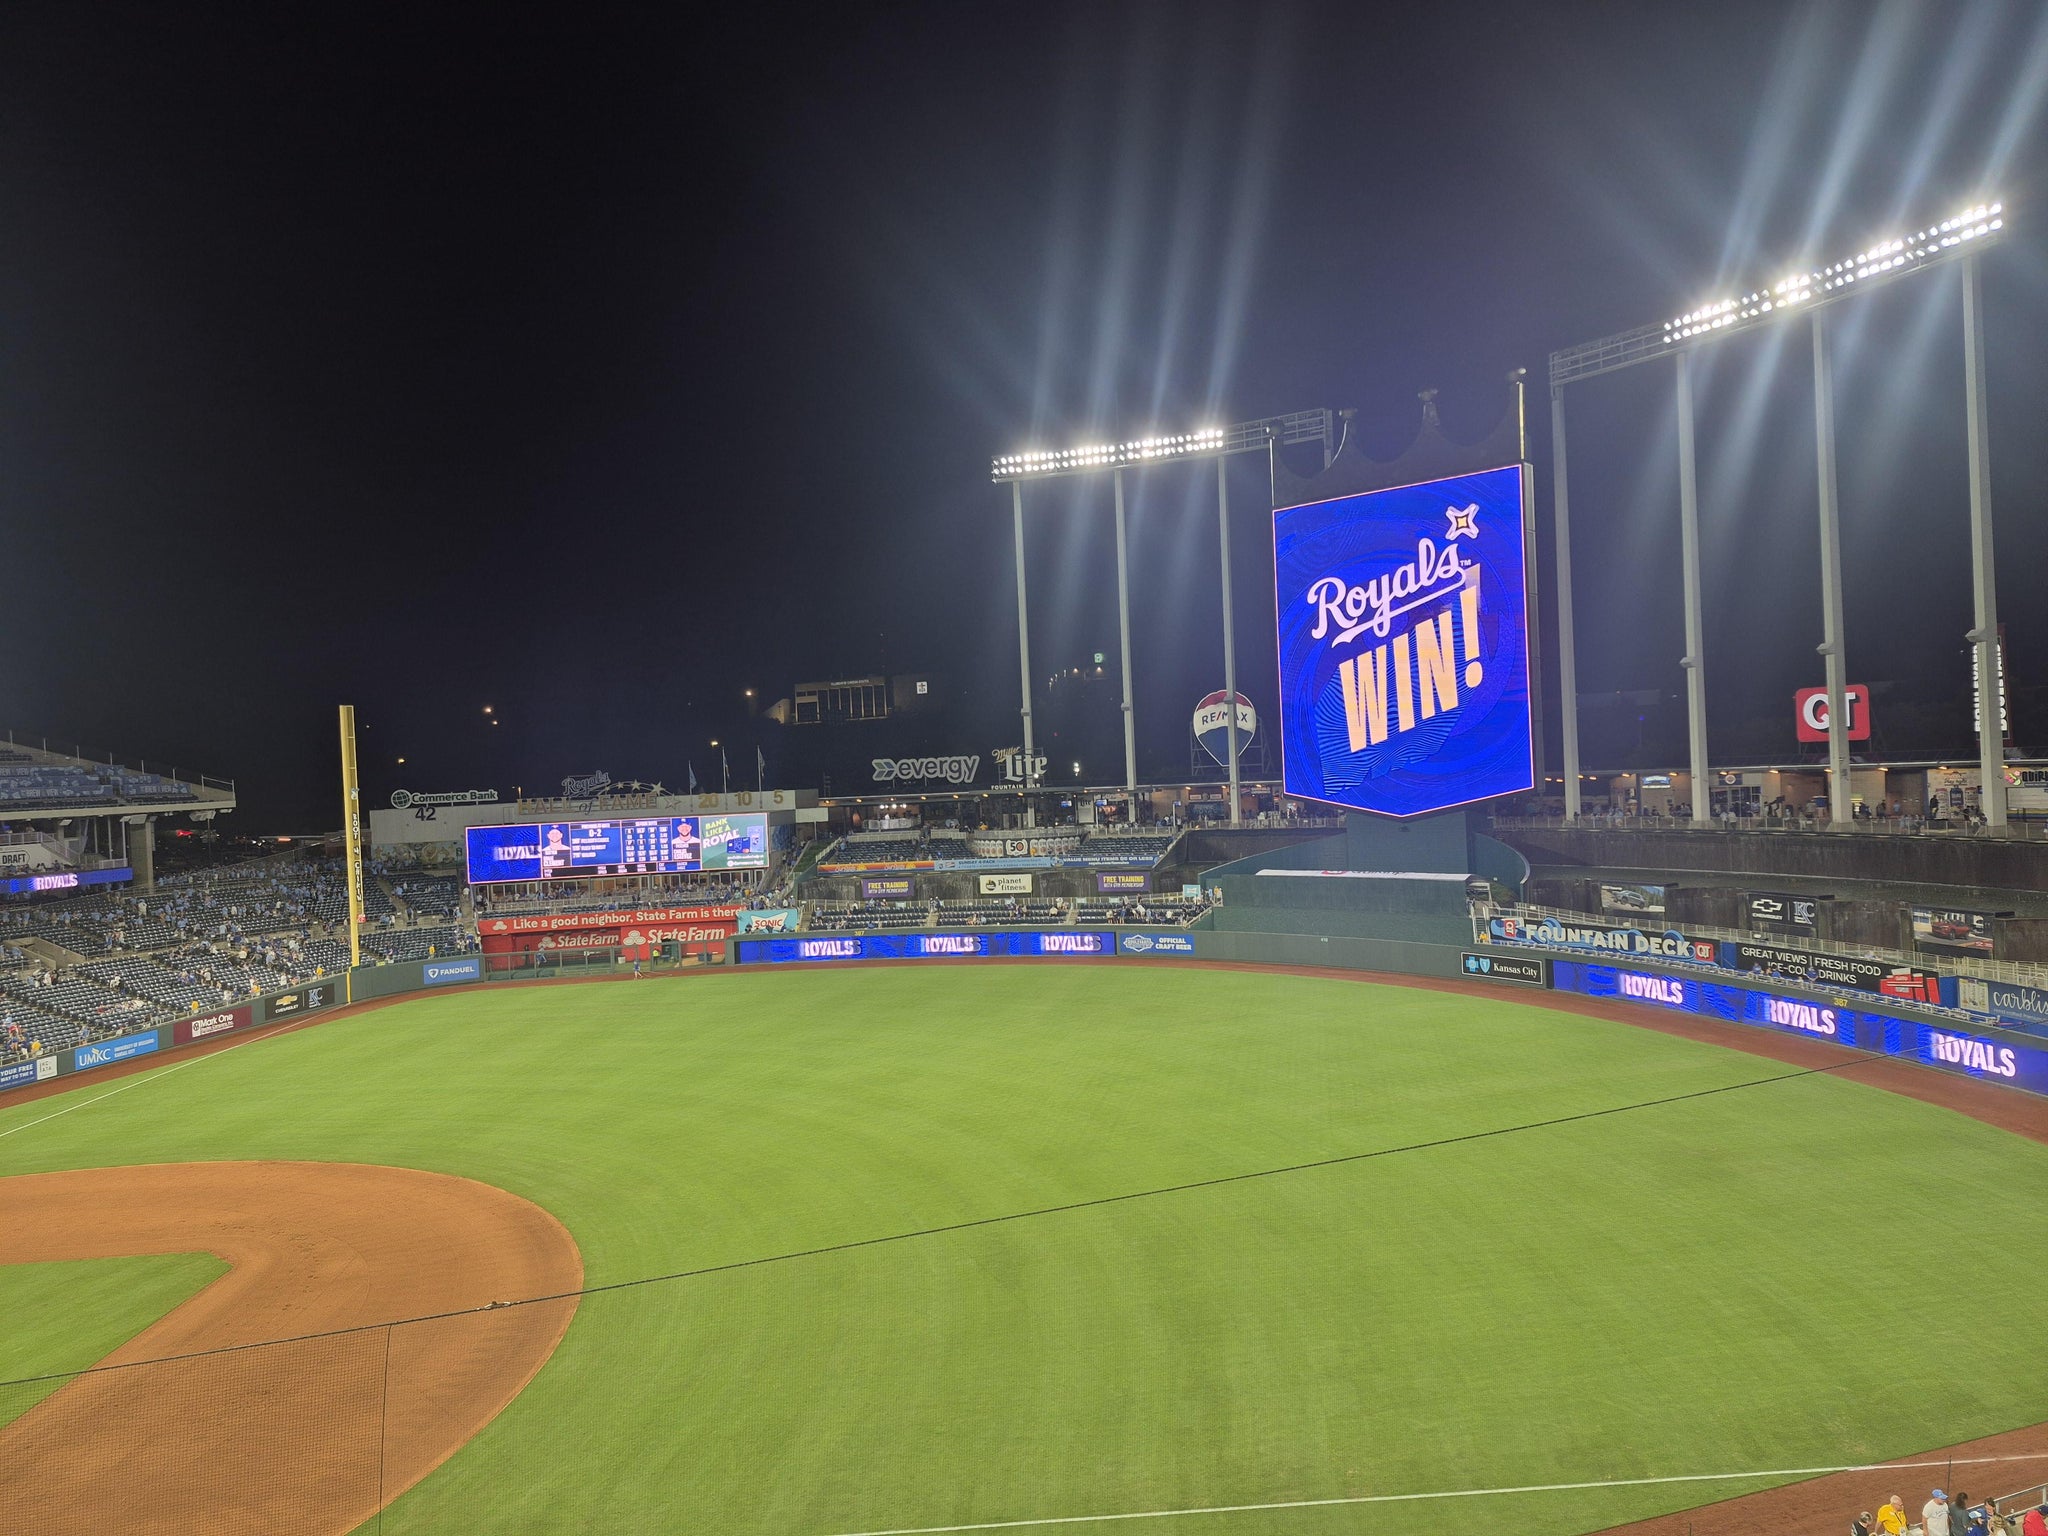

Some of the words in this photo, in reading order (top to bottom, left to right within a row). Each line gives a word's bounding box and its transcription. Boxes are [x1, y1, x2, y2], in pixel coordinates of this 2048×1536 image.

[1307, 537, 1466, 648] Royals
[1339, 580, 1483, 753] WIN!
[1803, 692, 1856, 730] QT
[992, 746, 1020, 763] Miller
[897, 756, 980, 783] evergy
[1004, 755, 1048, 782] Lite
[561, 770, 612, 798] Royals
[411, 793, 468, 803] Commerce
[469, 790, 497, 800] Bank
[517, 797, 576, 815] HALL
[578, 799, 593, 815] of
[598, 792, 658, 811] FAME
[698, 793, 720, 808] 20
[735, 791, 752, 806] 10
[774, 789, 784, 804] 5
[415, 807, 436, 822] 42
[705, 817, 728, 830] BANK
[705, 826, 724, 837] LIKE
[703, 829, 740, 849] ROYAL
[2, 853, 26, 865] DRAFT
[36, 873, 78, 890] ROYALS
[998, 877, 1022, 886] planet
[513, 919, 538, 930] Like
[541, 919, 548, 928] a
[551, 916, 578, 929] good
[581, 913, 634, 926] neighbor,
[636, 911, 667, 922] State
[669, 909, 698, 920] Farm
[701, 908, 710, 918] is
[754, 918, 783, 928] SONIC
[803, 941, 860, 957] ROYALS
[924, 937, 981, 953] ROYALS
[1044, 935, 1101, 952] ROYALS
[1526, 924, 1629, 950] FOUNTAIN
[1635, 934, 1691, 957] DECK
[1493, 962, 1520, 974] Kansas
[1522, 965, 1538, 978] City
[1742, 947, 1775, 960] GREAT
[1775, 951, 1808, 964] VIEWS
[1815, 958, 1849, 971] FRESH
[1851, 962, 1882, 976] FOOD
[440, 966, 475, 976] FANDUEL
[1818, 969, 1857, 984] DRINKS
[1623, 974, 1683, 1004] ROYALS
[200, 1017, 218, 1028] Mark
[218, 1014, 234, 1023] One
[1768, 998, 1836, 1035] ROYALS
[79, 1048, 111, 1066] UMKC
[1934, 1033, 2016, 1078] ROYALS
[0, 1067, 17, 1077] YOUR
[18, 1063, 34, 1072] FREE
